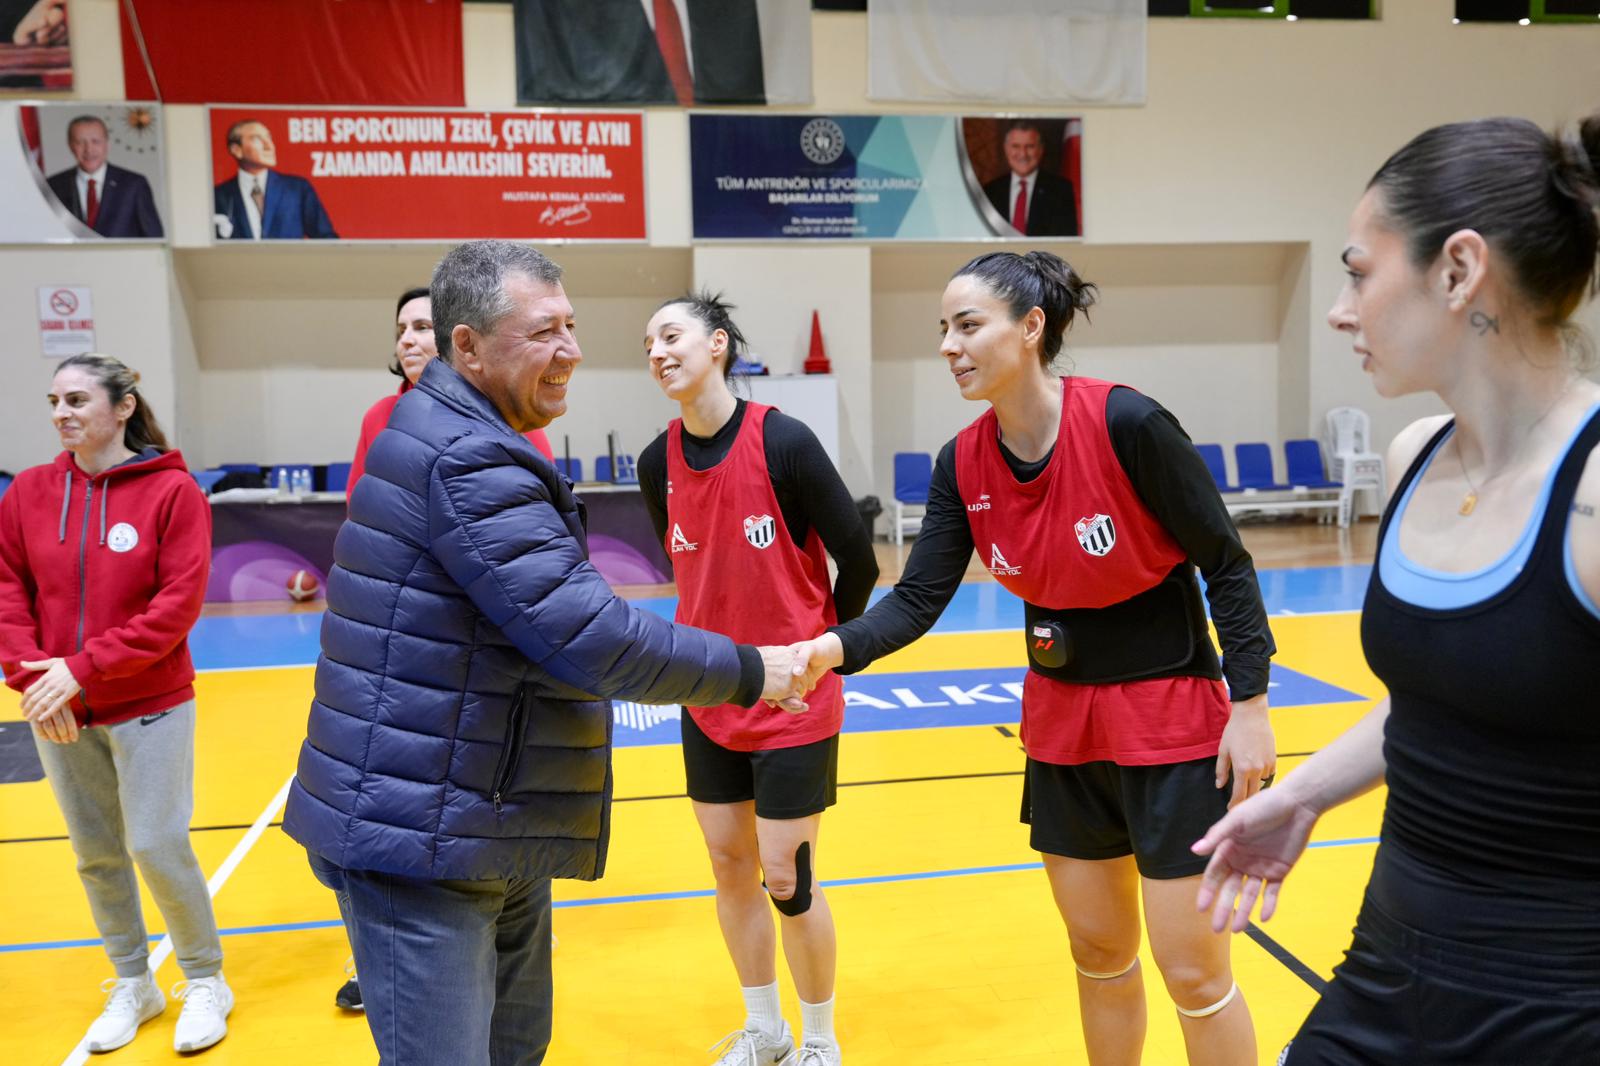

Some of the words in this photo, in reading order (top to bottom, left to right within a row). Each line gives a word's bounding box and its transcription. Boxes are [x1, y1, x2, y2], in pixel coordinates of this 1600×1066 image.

[288, 117, 327, 143] BEN
[331, 117, 446, 143] SPORCUNUN
[450, 112, 498, 148] ZEKİ,
[502, 113, 556, 150] ÇEVİK
[559, 120, 583, 145] VE
[586, 121, 631, 146] AYNI
[310, 151, 406, 177] ZAMANDA
[409, 151, 523, 177] AHLAKLISINI
[527, 147, 613, 179] SEVERİM.
[716, 176, 745, 190] TÜM
[746, 176, 810, 190] ANTRENÖR
[811, 178, 827, 190] VE
[502, 191, 548, 202] MUSTAFA
[582, 190, 625, 203] ATATÜRK
